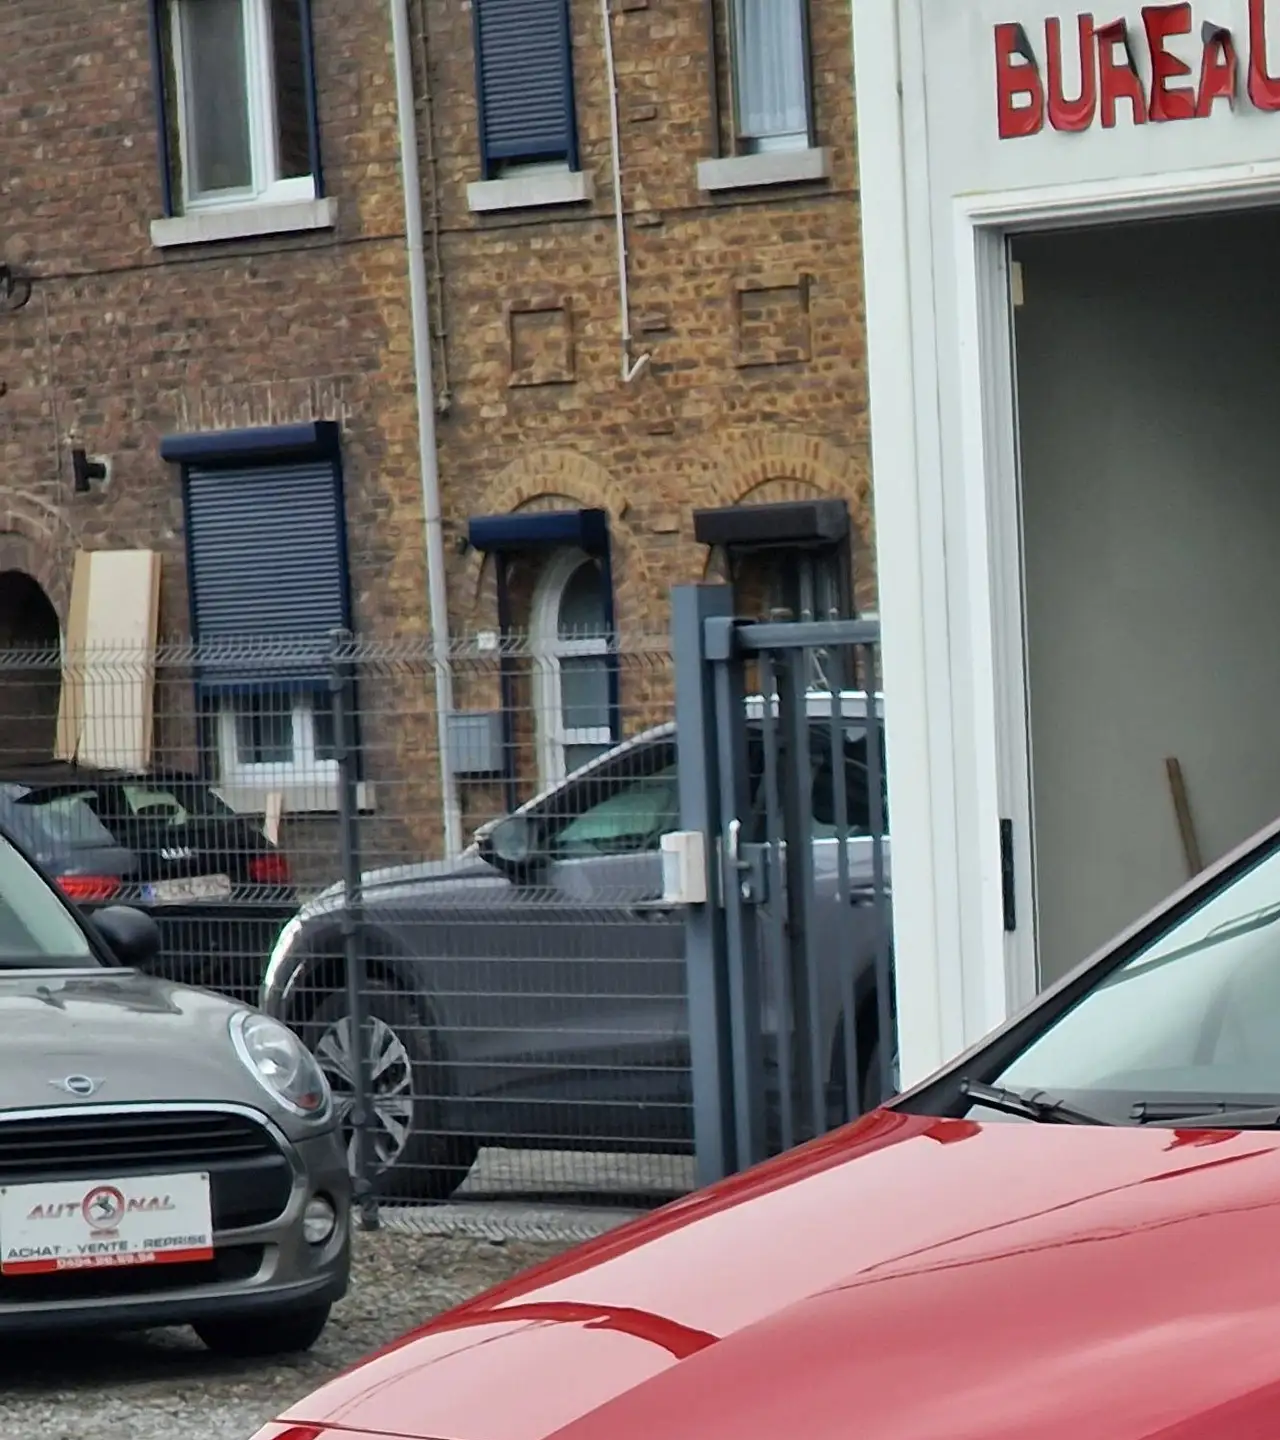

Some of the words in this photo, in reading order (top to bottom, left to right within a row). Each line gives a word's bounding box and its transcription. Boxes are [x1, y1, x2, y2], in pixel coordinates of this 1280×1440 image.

[7, 1245, 62, 1259] ACHAT
[77, 1240, 128, 1254] VENTE
[143, 1235, 207, 1249] REPRISE
